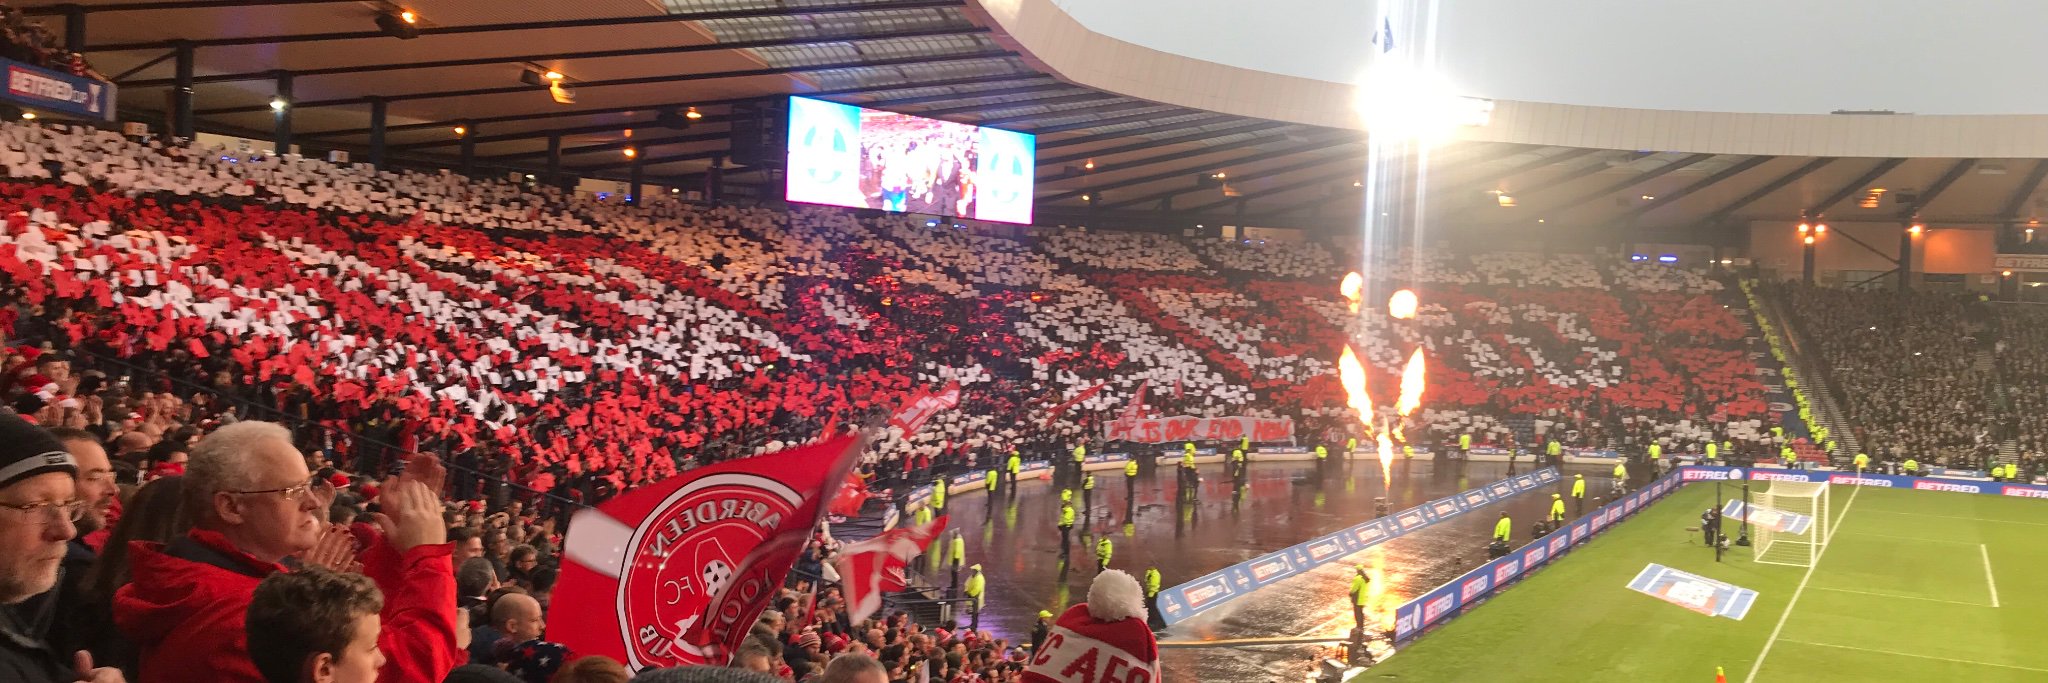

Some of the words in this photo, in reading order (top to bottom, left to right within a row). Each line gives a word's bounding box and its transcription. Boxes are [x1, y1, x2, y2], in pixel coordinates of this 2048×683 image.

[11, 69, 73, 101] BETFRED
[1138, 421, 1162, 443] IS
[1165, 418, 1200, 441] OUR
[1206, 418, 1243, 440] END
[1253, 419, 1291, 442] NOW
[1752, 472, 1809, 483] BETFRED
[1832, 476, 1893, 488] BETFRED
[1915, 482, 1981, 494] BETFRED
[1494, 559, 1519, 586] BETFRED
[1462, 574, 1489, 603] BETFRED
[1424, 593, 1455, 622] BETFRED
